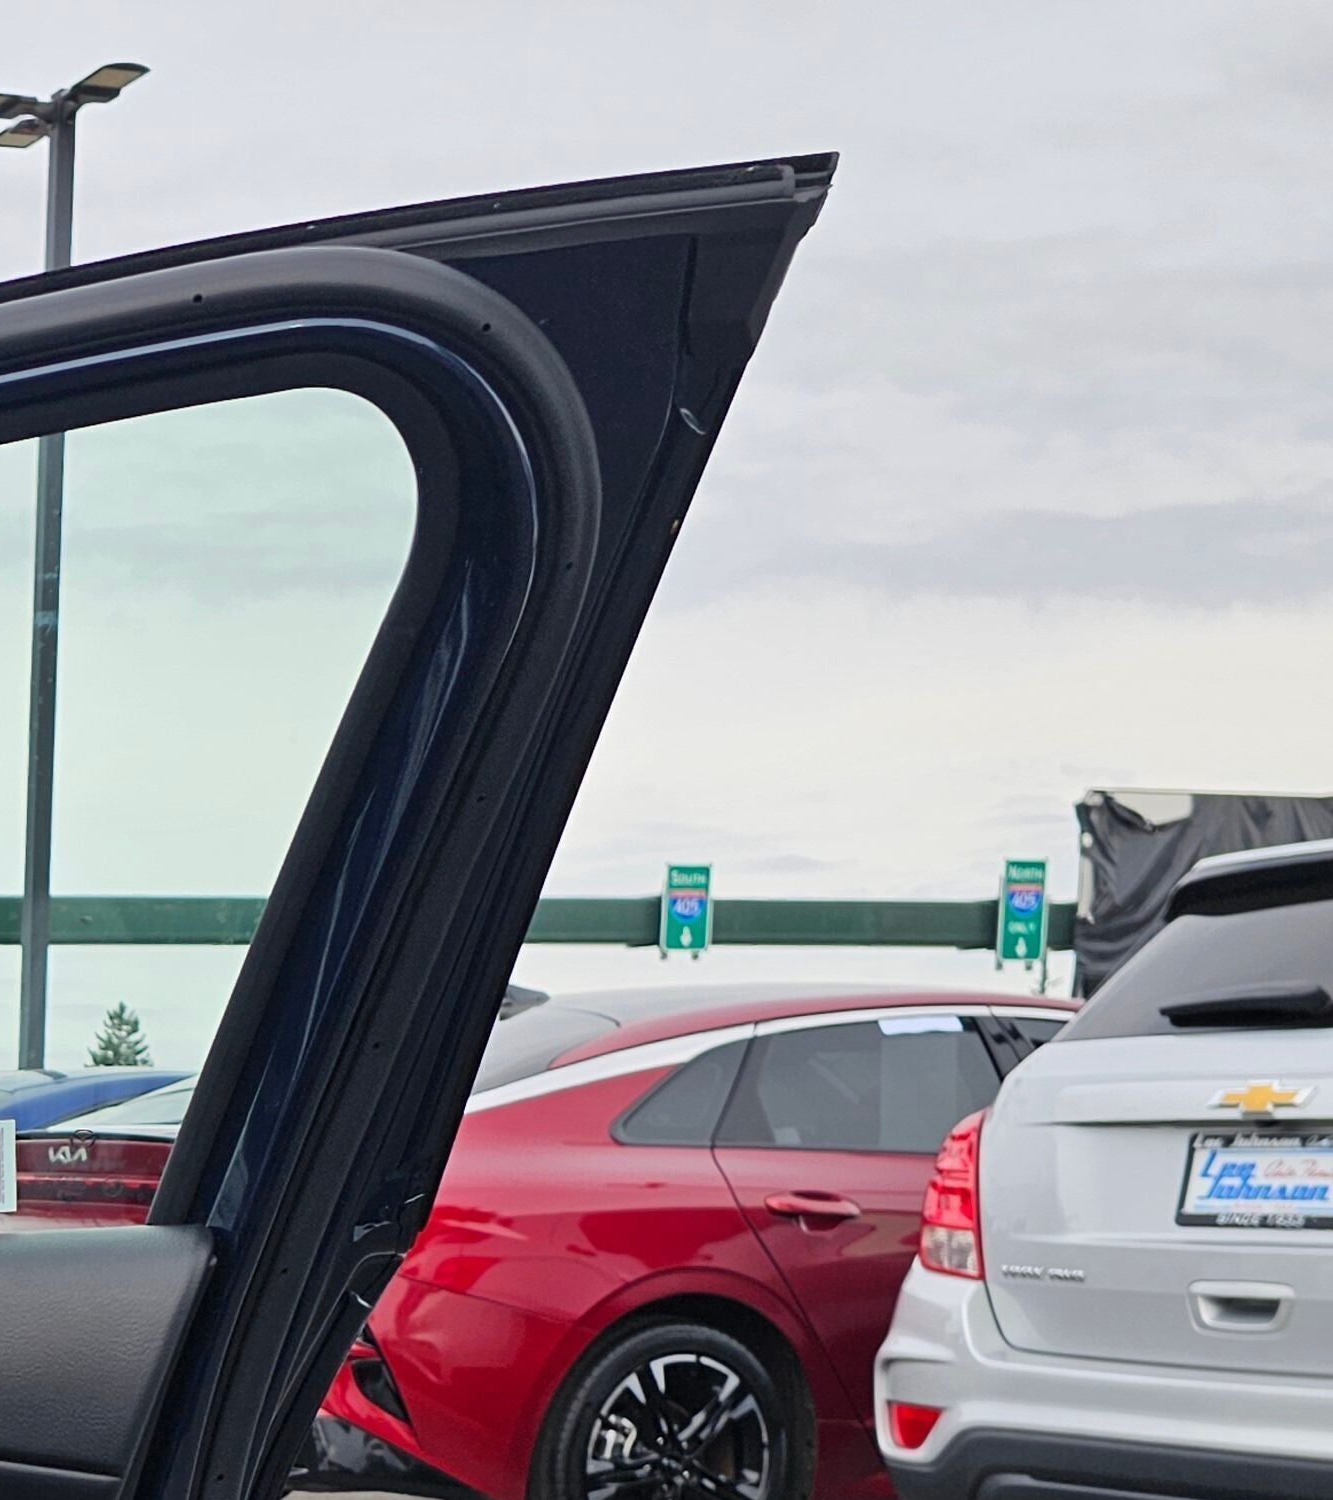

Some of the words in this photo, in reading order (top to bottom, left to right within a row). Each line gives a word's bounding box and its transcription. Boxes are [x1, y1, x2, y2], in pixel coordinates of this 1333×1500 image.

[671, 869, 706, 886] SOUTH
[673, 896, 701, 916] 405
[1012, 891, 1037, 909] 405
